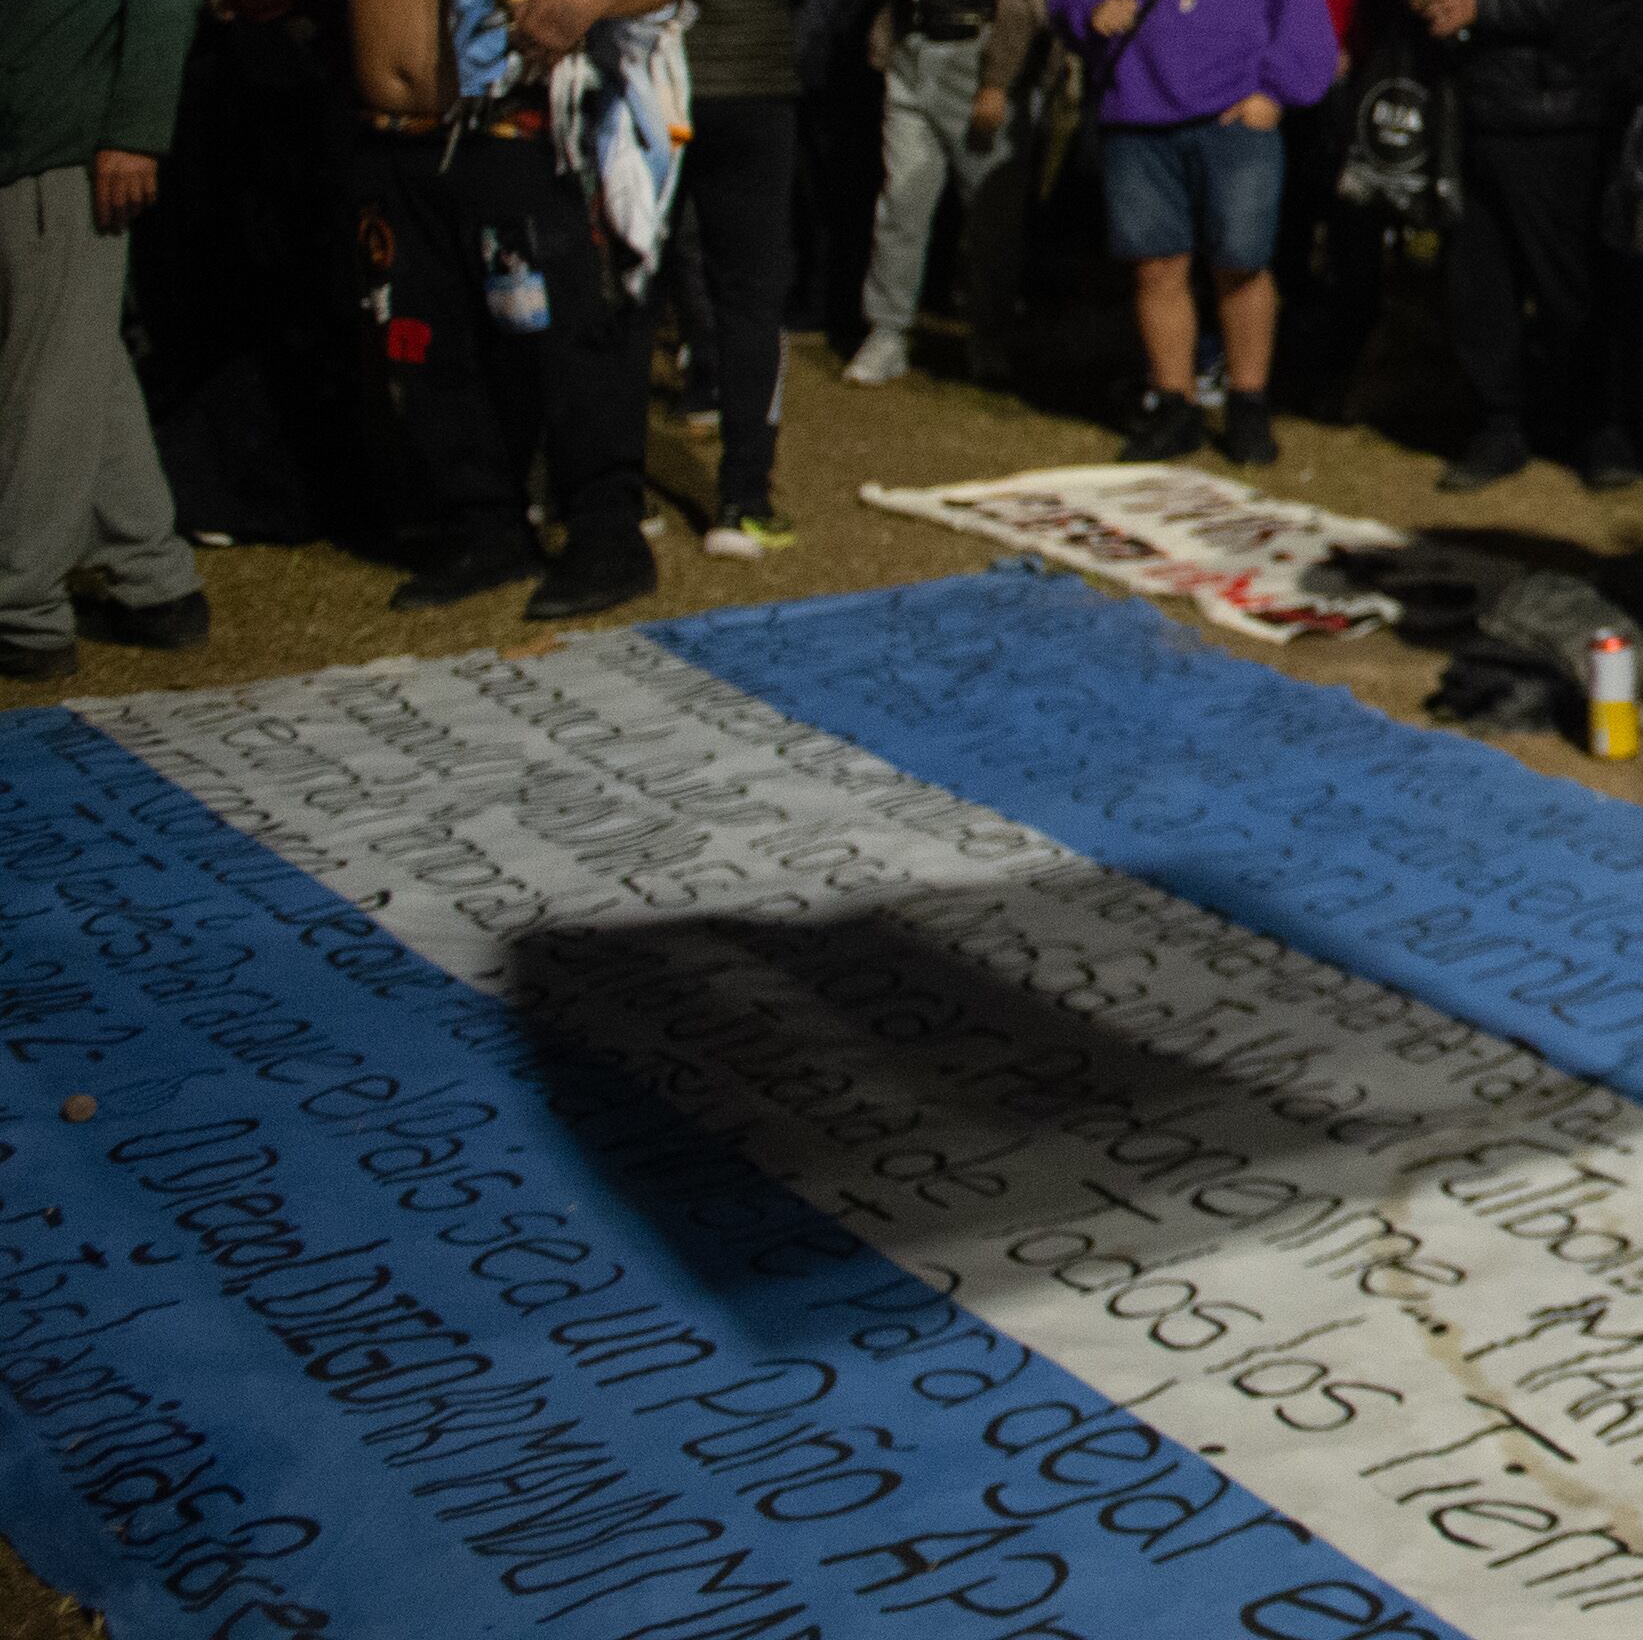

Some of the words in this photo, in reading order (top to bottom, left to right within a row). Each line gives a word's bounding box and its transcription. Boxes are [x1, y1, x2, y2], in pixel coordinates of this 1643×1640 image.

[437, 1214, 621, 1314] sea
[549, 1306, 714, 1386] un
[638, 1357, 905, 1521] Puño
[981, 1384, 1312, 1563] dejar
